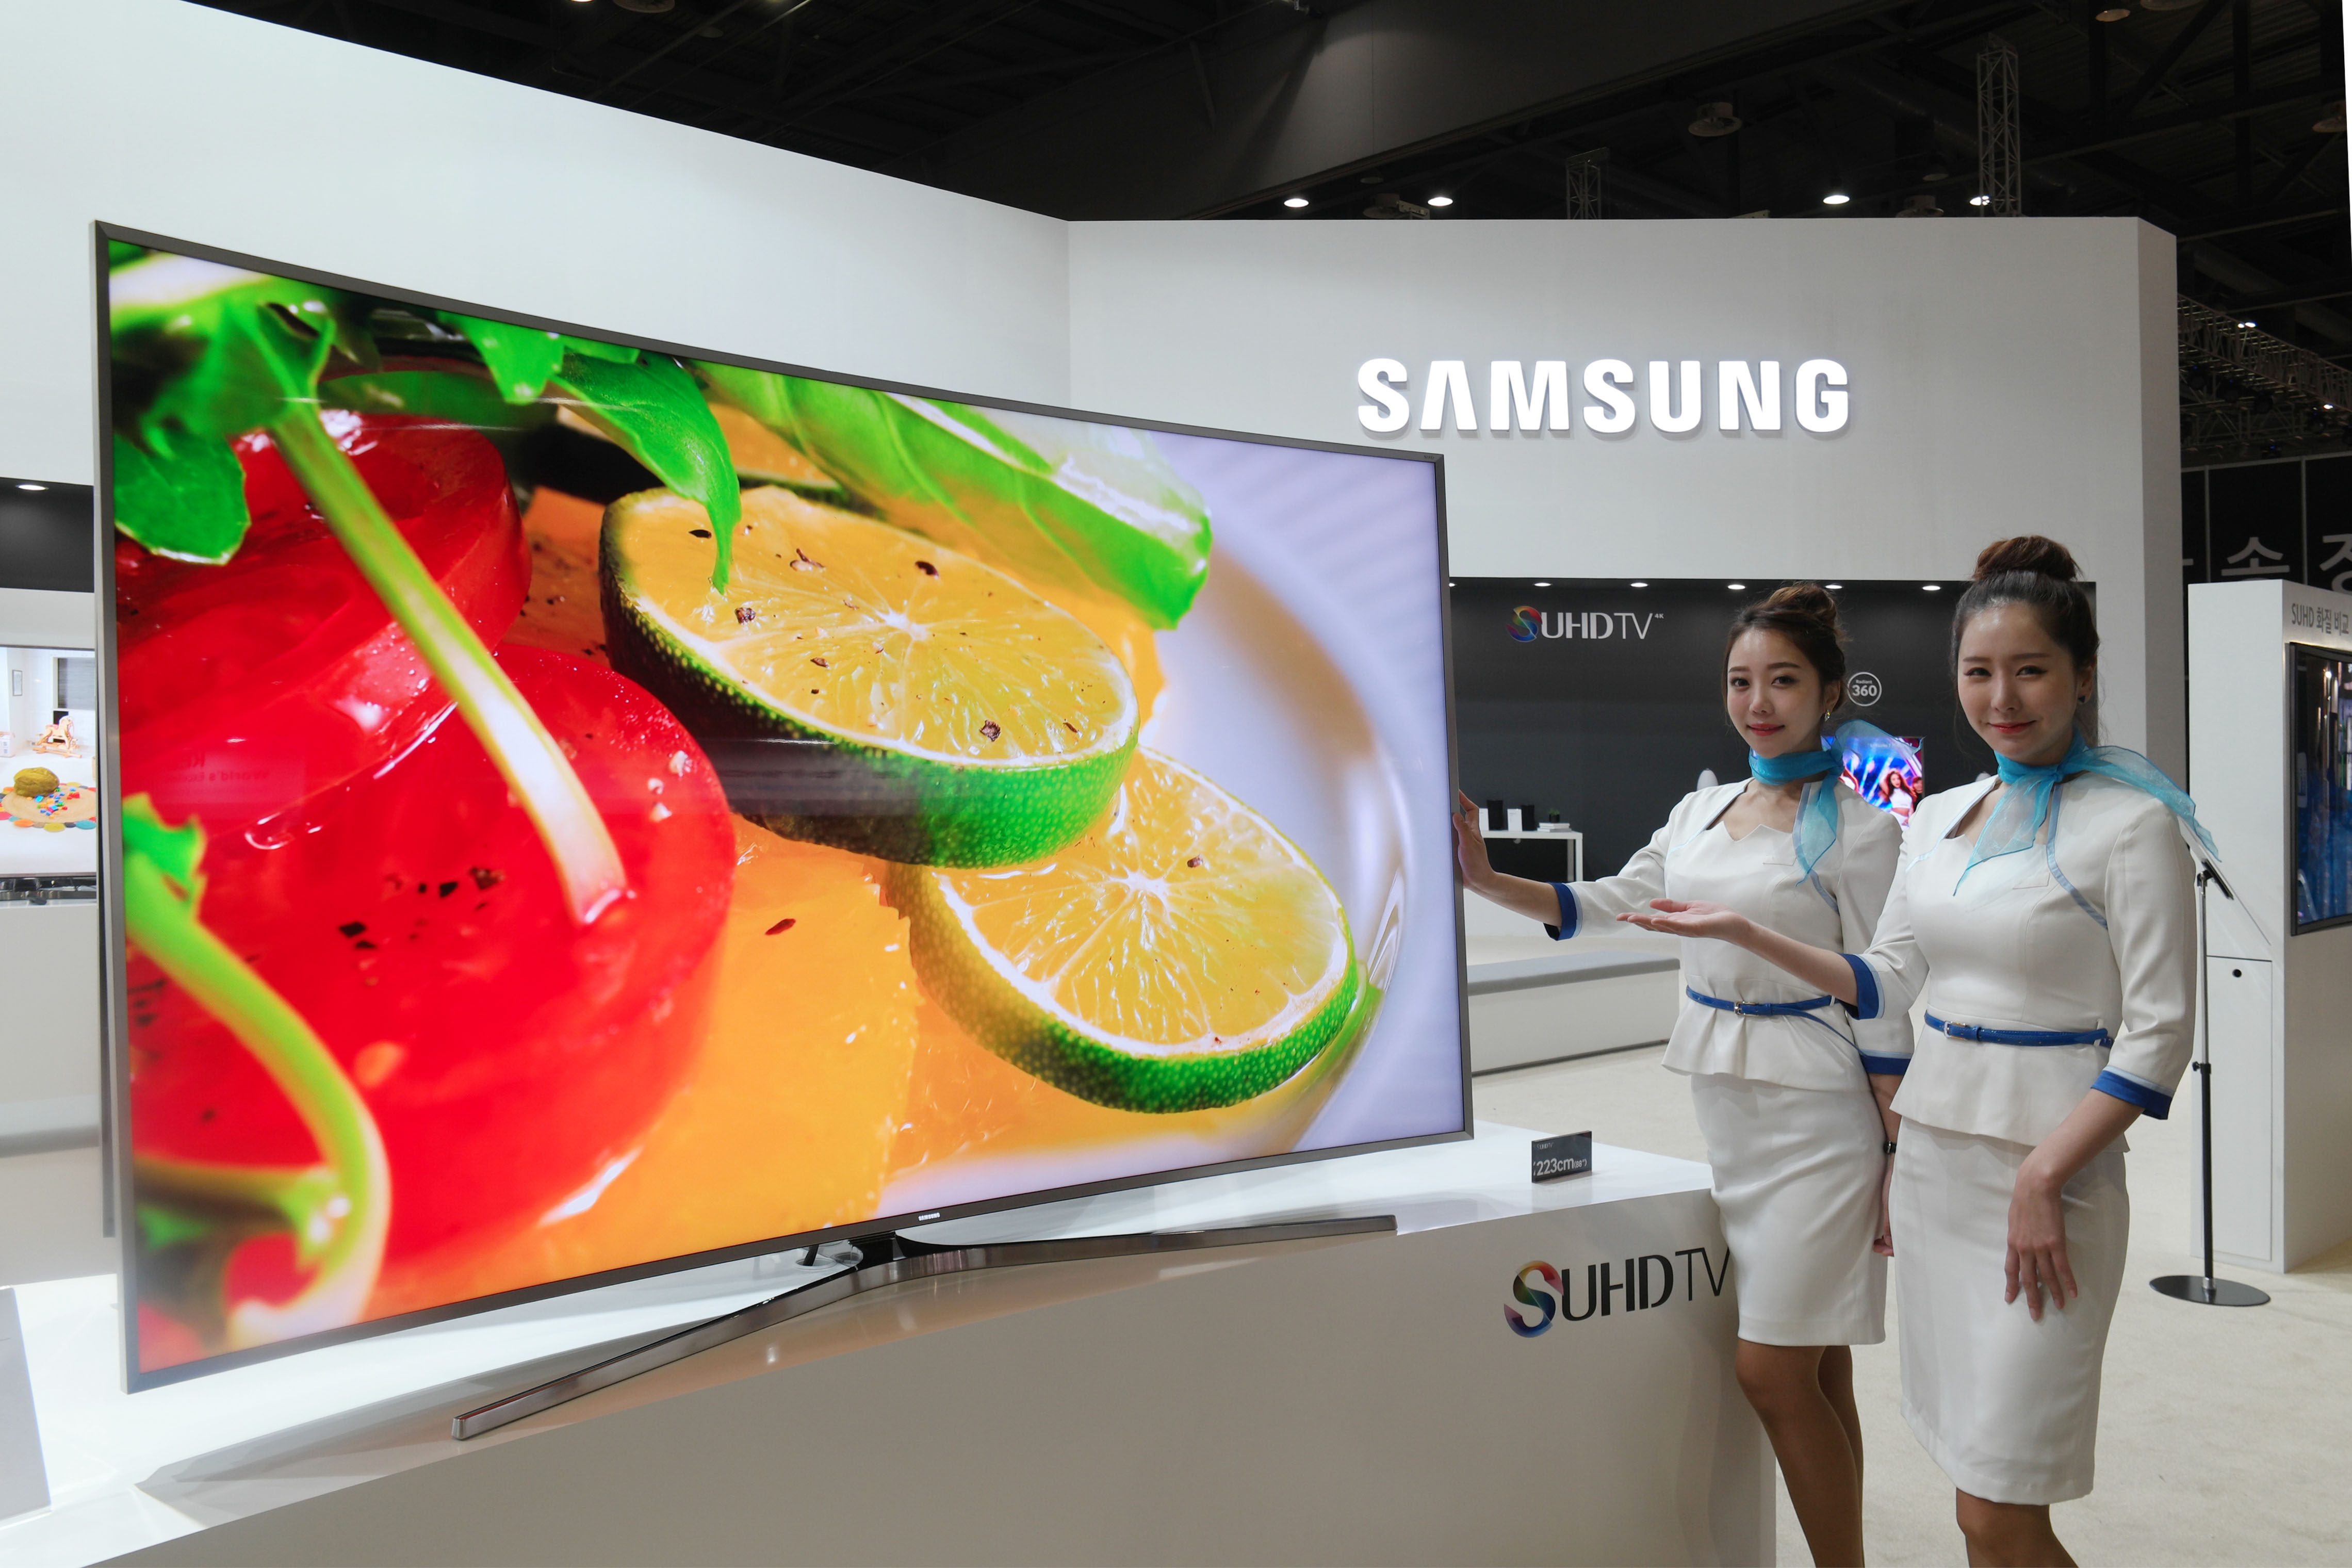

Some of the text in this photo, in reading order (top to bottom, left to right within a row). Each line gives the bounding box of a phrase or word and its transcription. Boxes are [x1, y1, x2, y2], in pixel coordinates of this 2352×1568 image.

[1357, 357, 1849, 433] SAMSUNG
[2292, 603, 2349, 636] SUHD 화질 비교
[1852, 684, 1877, 696] 360
[918, 1212, 940, 1221] SAMSUNG
